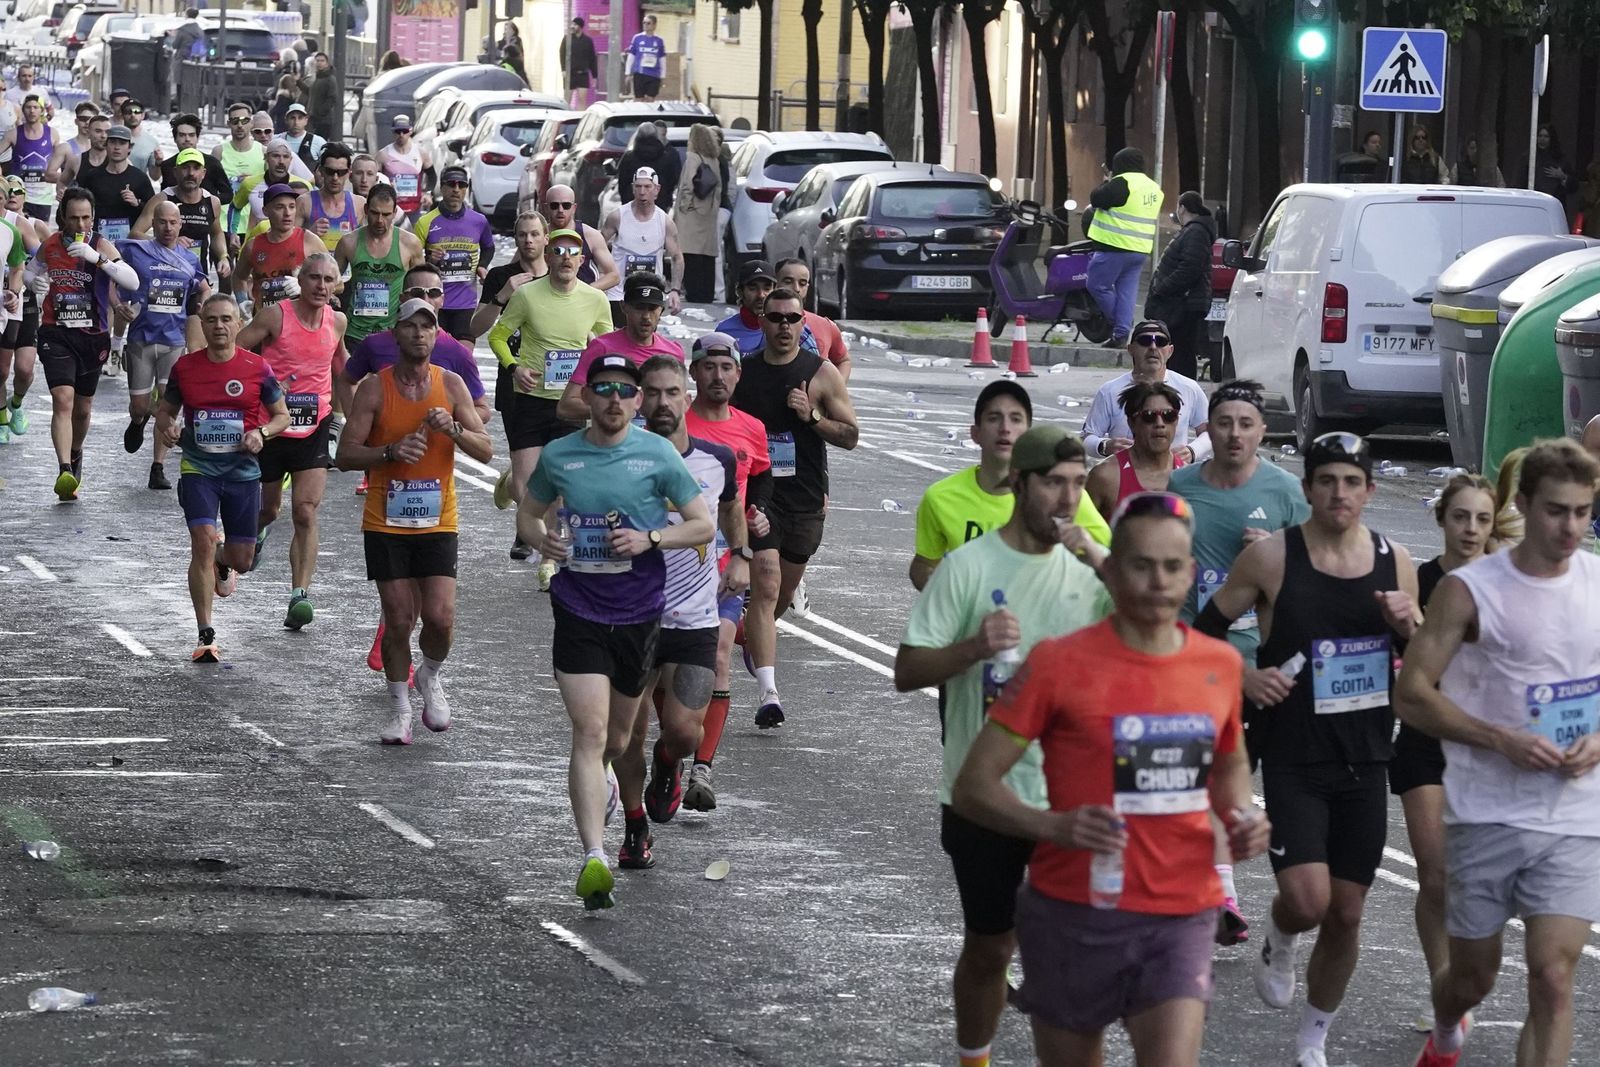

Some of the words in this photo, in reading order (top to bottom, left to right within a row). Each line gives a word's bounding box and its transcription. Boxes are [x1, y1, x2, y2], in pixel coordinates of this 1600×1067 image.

[919, 278, 946, 288] 4249
[949, 278, 969, 288] GBR
[156, 296, 178, 306] ANGEL
[58, 311, 87, 320] JUANCA
[1373, 337, 1406, 350] 9177
[1410, 338, 1435, 350] MFY
[196, 433, 242, 443] BARREIRO
[407, 482, 435, 490] ZURICH
[400, 506, 430, 517] JORDI
[585, 517, 609, 526] ZURI
[1340, 640, 1384, 654] ZURICH
[1331, 676, 1375, 695] GOITIA
[1557, 680, 1598, 698] ZURICH
[1150, 718, 1206, 735] ZURICH
[1135, 766, 1200, 791] CHUBY
